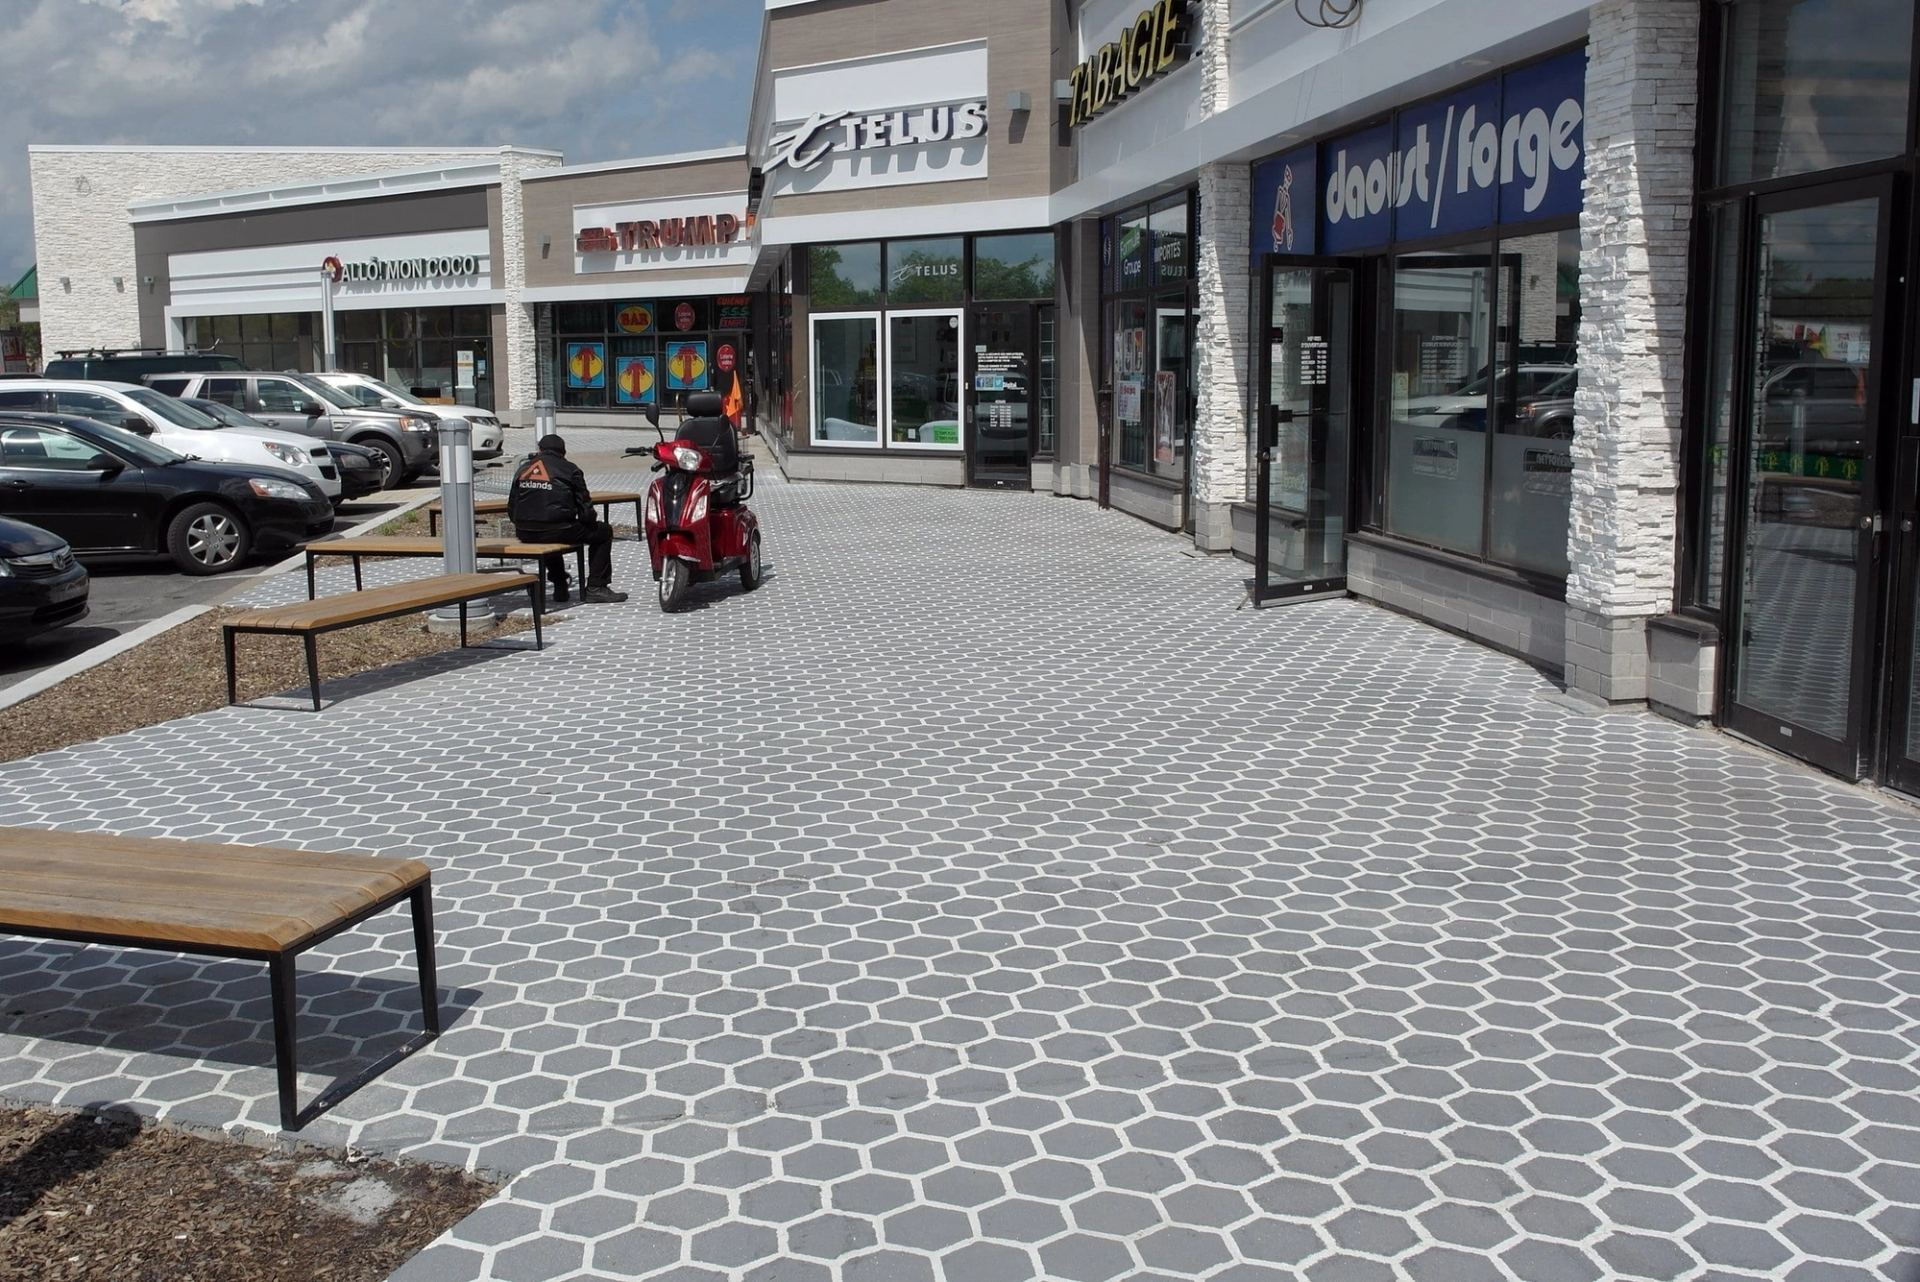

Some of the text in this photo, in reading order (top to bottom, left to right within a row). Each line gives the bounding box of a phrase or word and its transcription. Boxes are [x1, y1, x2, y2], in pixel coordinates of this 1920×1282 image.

[1069, 0, 1179, 128] TABAGIE
[837, 102, 987, 151] TELUS
[616, 213, 740, 251] TRUMP
[385, 258, 426, 281] MON
[426, 254, 480, 278] COCO
[915, 263, 958, 277] TELUS
[620, 312, 649, 326] BAR
